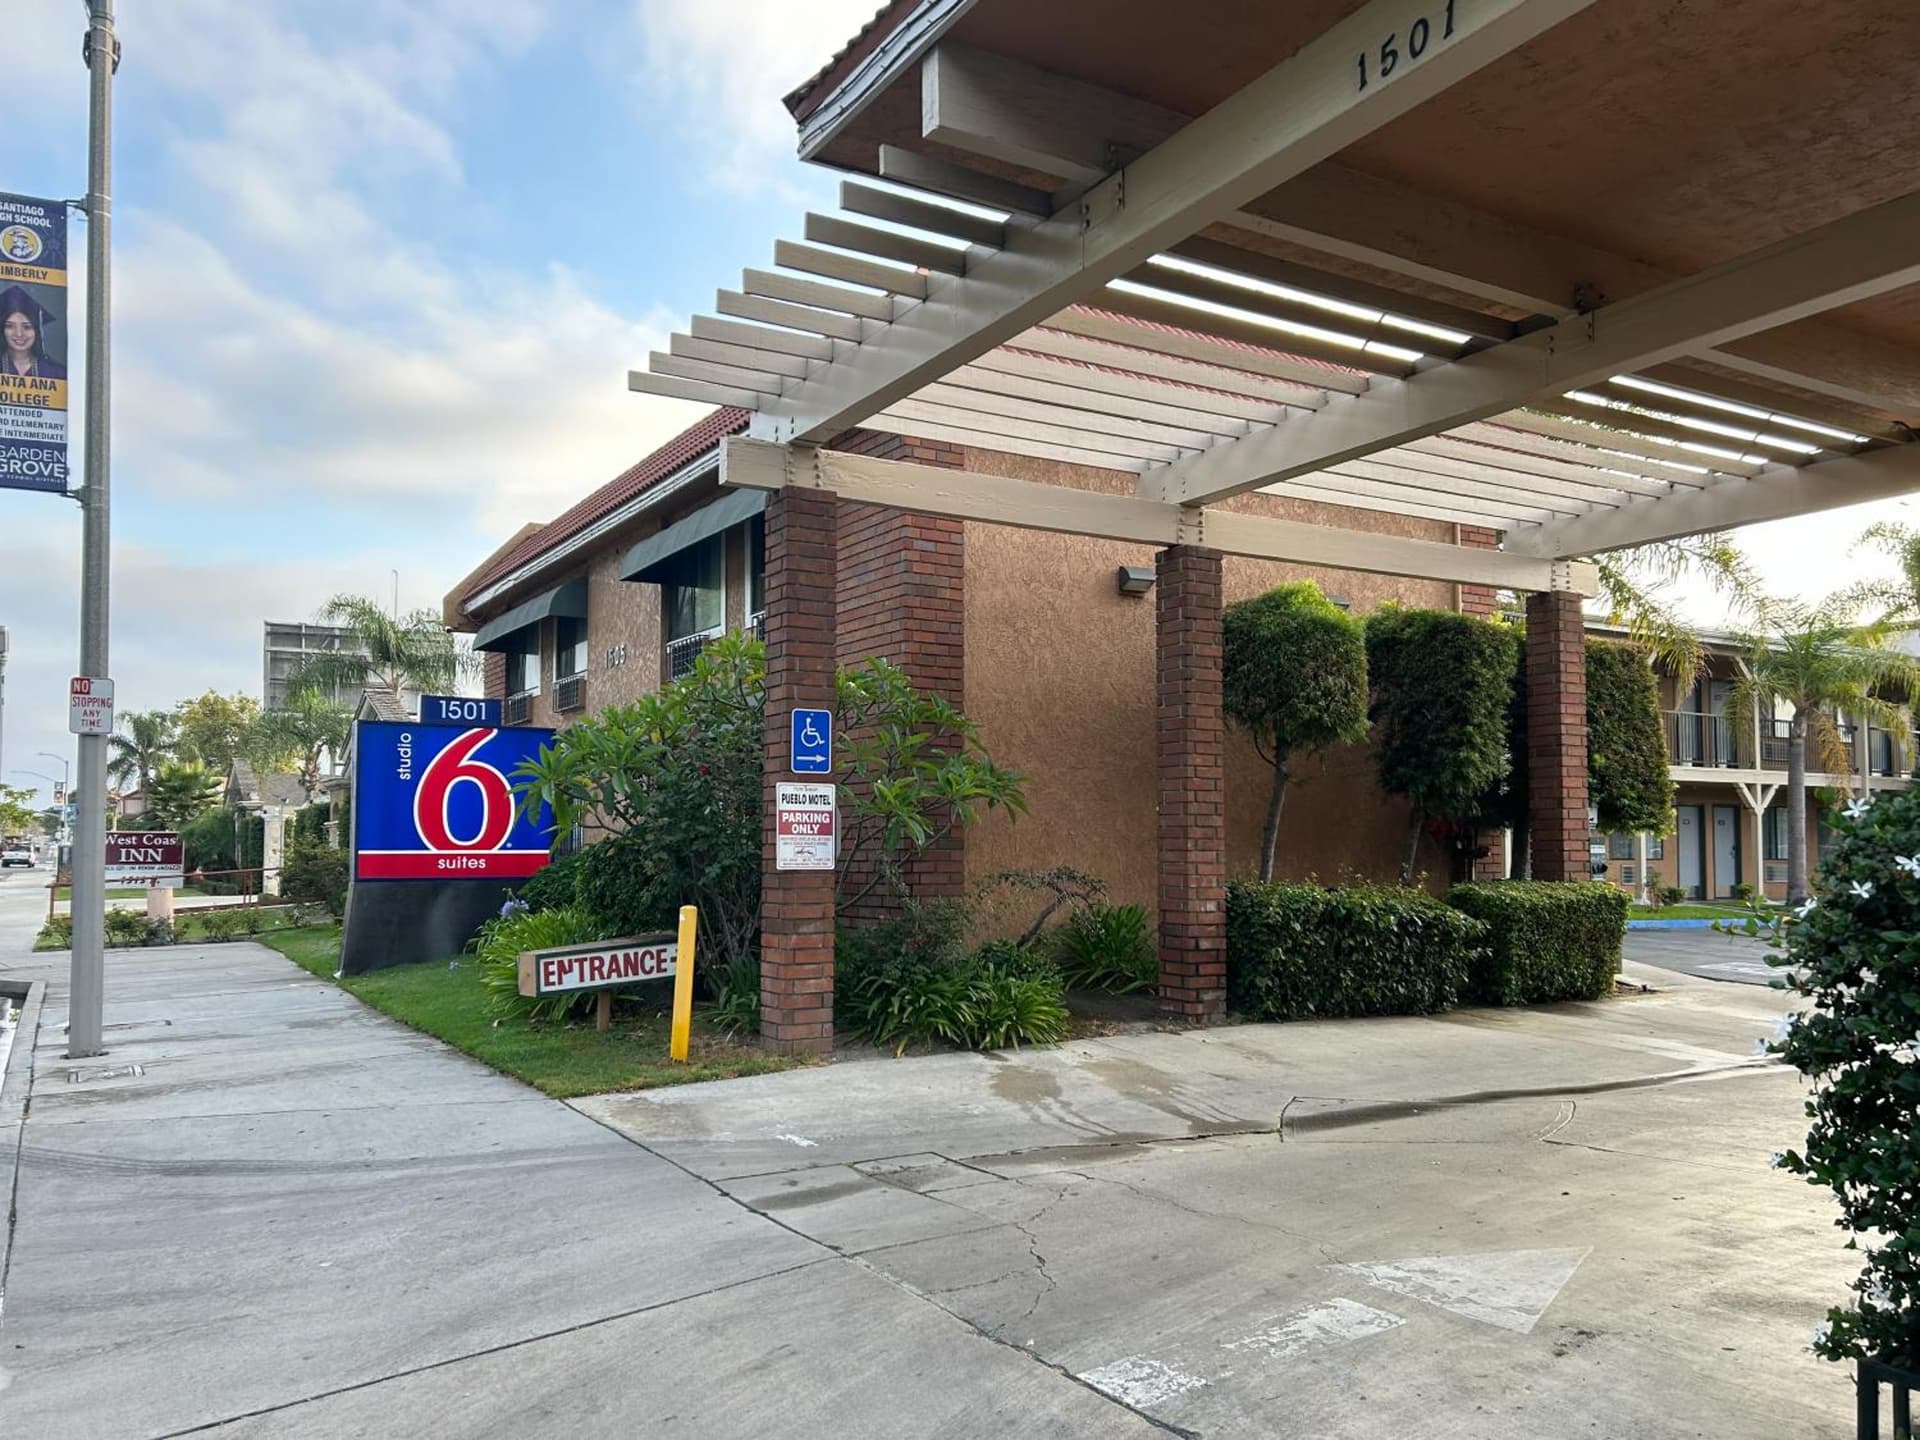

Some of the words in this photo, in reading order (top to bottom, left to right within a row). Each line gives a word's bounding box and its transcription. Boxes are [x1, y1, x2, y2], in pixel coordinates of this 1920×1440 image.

[1358, 0, 1454, 93] 1501
[14, 214, 52, 229] SCHOOL
[30, 378, 57, 392] ANA
[11, 418, 65, 432] ELEMENTARY
[4, 429, 64, 441] INTERMEDIATE
[0, 458, 65, 479] GROVE
[73, 679, 90, 693] NO
[72, 696, 113, 709] STOPPING
[82, 709, 101, 718] ANY
[439, 700, 487, 721] 1501
[81, 719, 102, 728] TIME
[397, 732, 413, 780] studio
[413, 727, 516, 852] 6
[781, 793, 807, 805] PUEBLO
[808, 794, 831, 806] MOTEL
[782, 812, 830, 824] PARKING
[791, 823, 820, 834] ONLY
[142, 833, 178, 846] Coas
[119, 848, 164, 862] INN
[437, 856, 487, 870] suites
[542, 948, 668, 987] ENTRANCE
